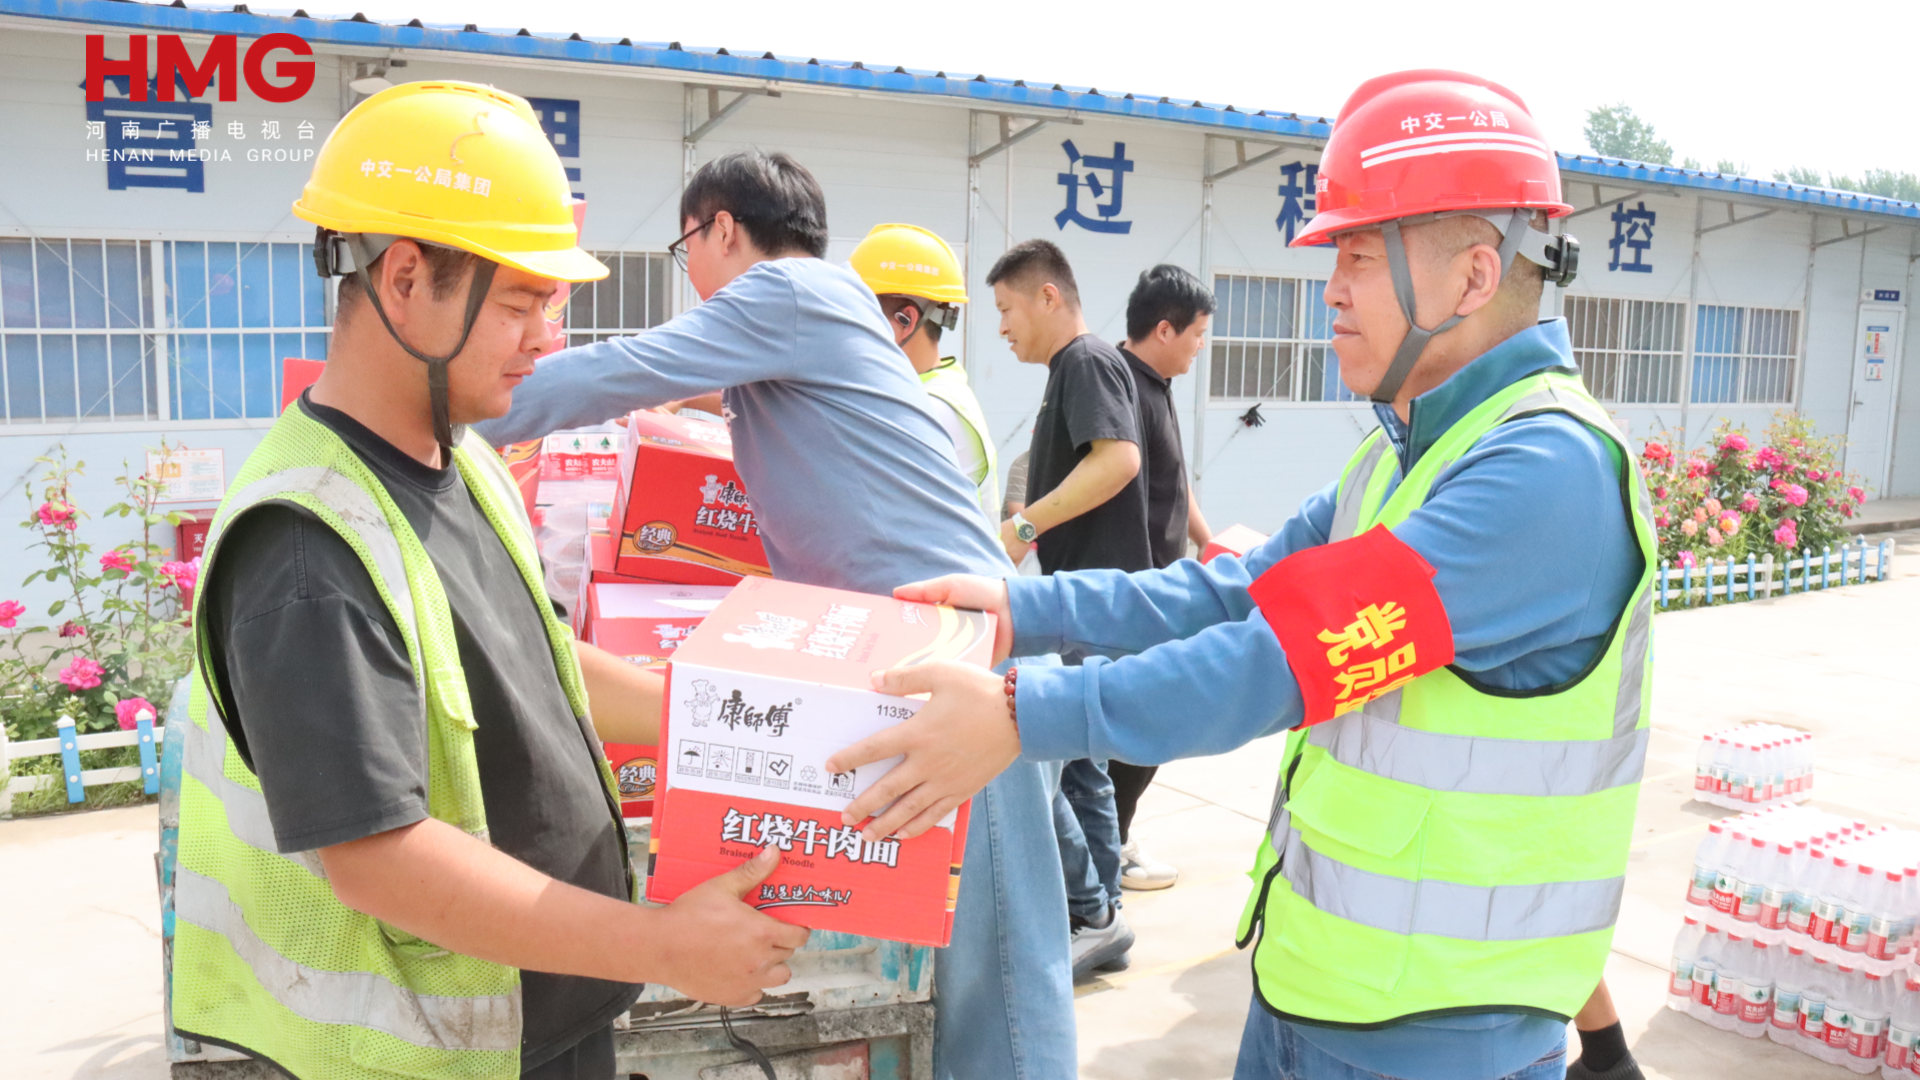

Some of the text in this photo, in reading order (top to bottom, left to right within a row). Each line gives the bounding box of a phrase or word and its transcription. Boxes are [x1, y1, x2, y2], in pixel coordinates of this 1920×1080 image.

[1401, 110, 1509, 134] 中交一公局
[361, 159, 491, 197] 中交一公局集团
[1054, 139, 1134, 234] 过
[1608, 201, 1656, 273] 控
[640, 524, 671, 545] 经典
[695, 506, 760, 537] 红烧牛
[619, 765, 656, 785] 经典
[721, 807, 902, 868] 红烧牛肉面
[719, 847, 815, 869] Braised Noodle
